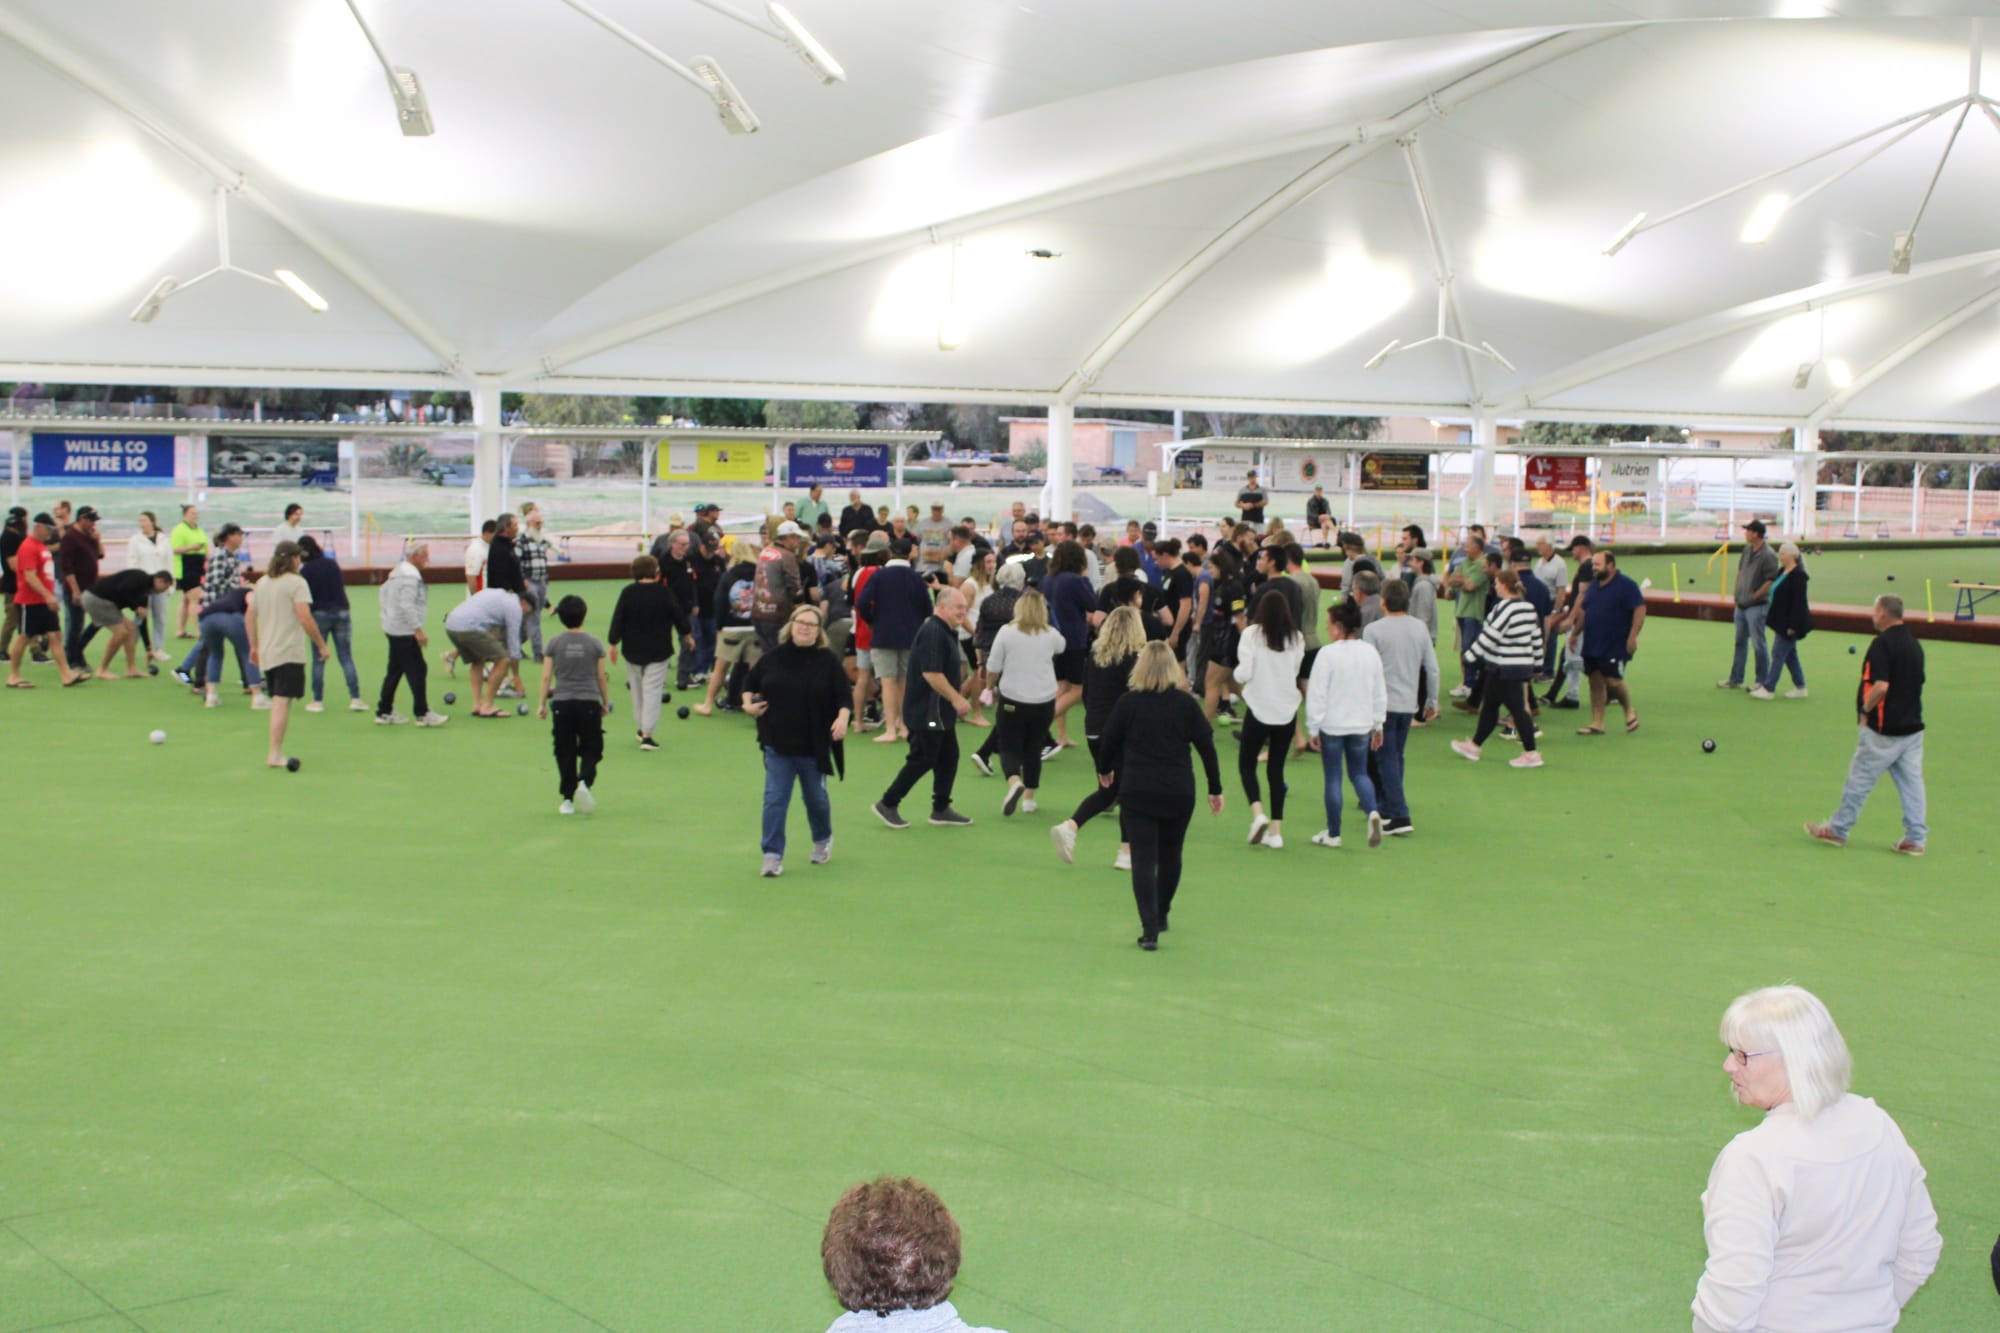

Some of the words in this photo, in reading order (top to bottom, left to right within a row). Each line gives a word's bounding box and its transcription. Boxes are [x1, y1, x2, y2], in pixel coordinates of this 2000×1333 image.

[64, 440, 109, 453] WILLS
[111, 441, 123, 453] &
[125, 440, 148, 454] CO
[796, 446, 835, 456] waikerie
[836, 446, 882, 458] pharmacy
[64, 456, 120, 472] MITRE
[126, 456, 148, 472] 10
[1611, 461, 1650, 476] Nutrien
